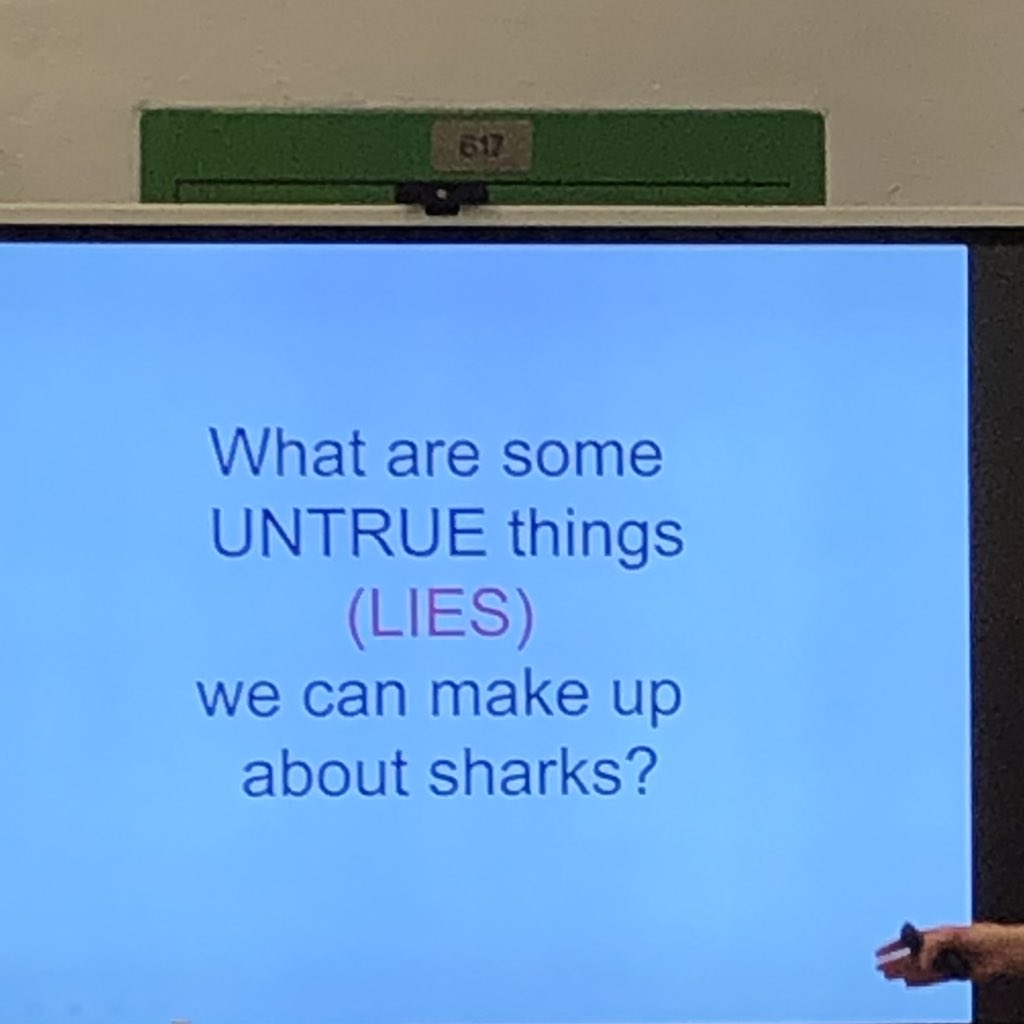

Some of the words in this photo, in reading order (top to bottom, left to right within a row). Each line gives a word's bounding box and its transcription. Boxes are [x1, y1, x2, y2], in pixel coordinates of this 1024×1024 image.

[459, 132, 504, 158] 617
[209, 427, 366, 478] What
[388, 439, 480, 478] are
[503, 439, 663, 478] some
[212, 506, 487, 558] UNTRUE
[508, 506, 684, 571] things
[348, 587, 533, 652] (LIES)
[195, 680, 281, 718] we
[303, 679, 407, 718] can
[431, 666, 590, 718] make
[612, 678, 682, 729] up
[242, 747, 410, 798] about
[429, 745, 658, 798] sharks?
